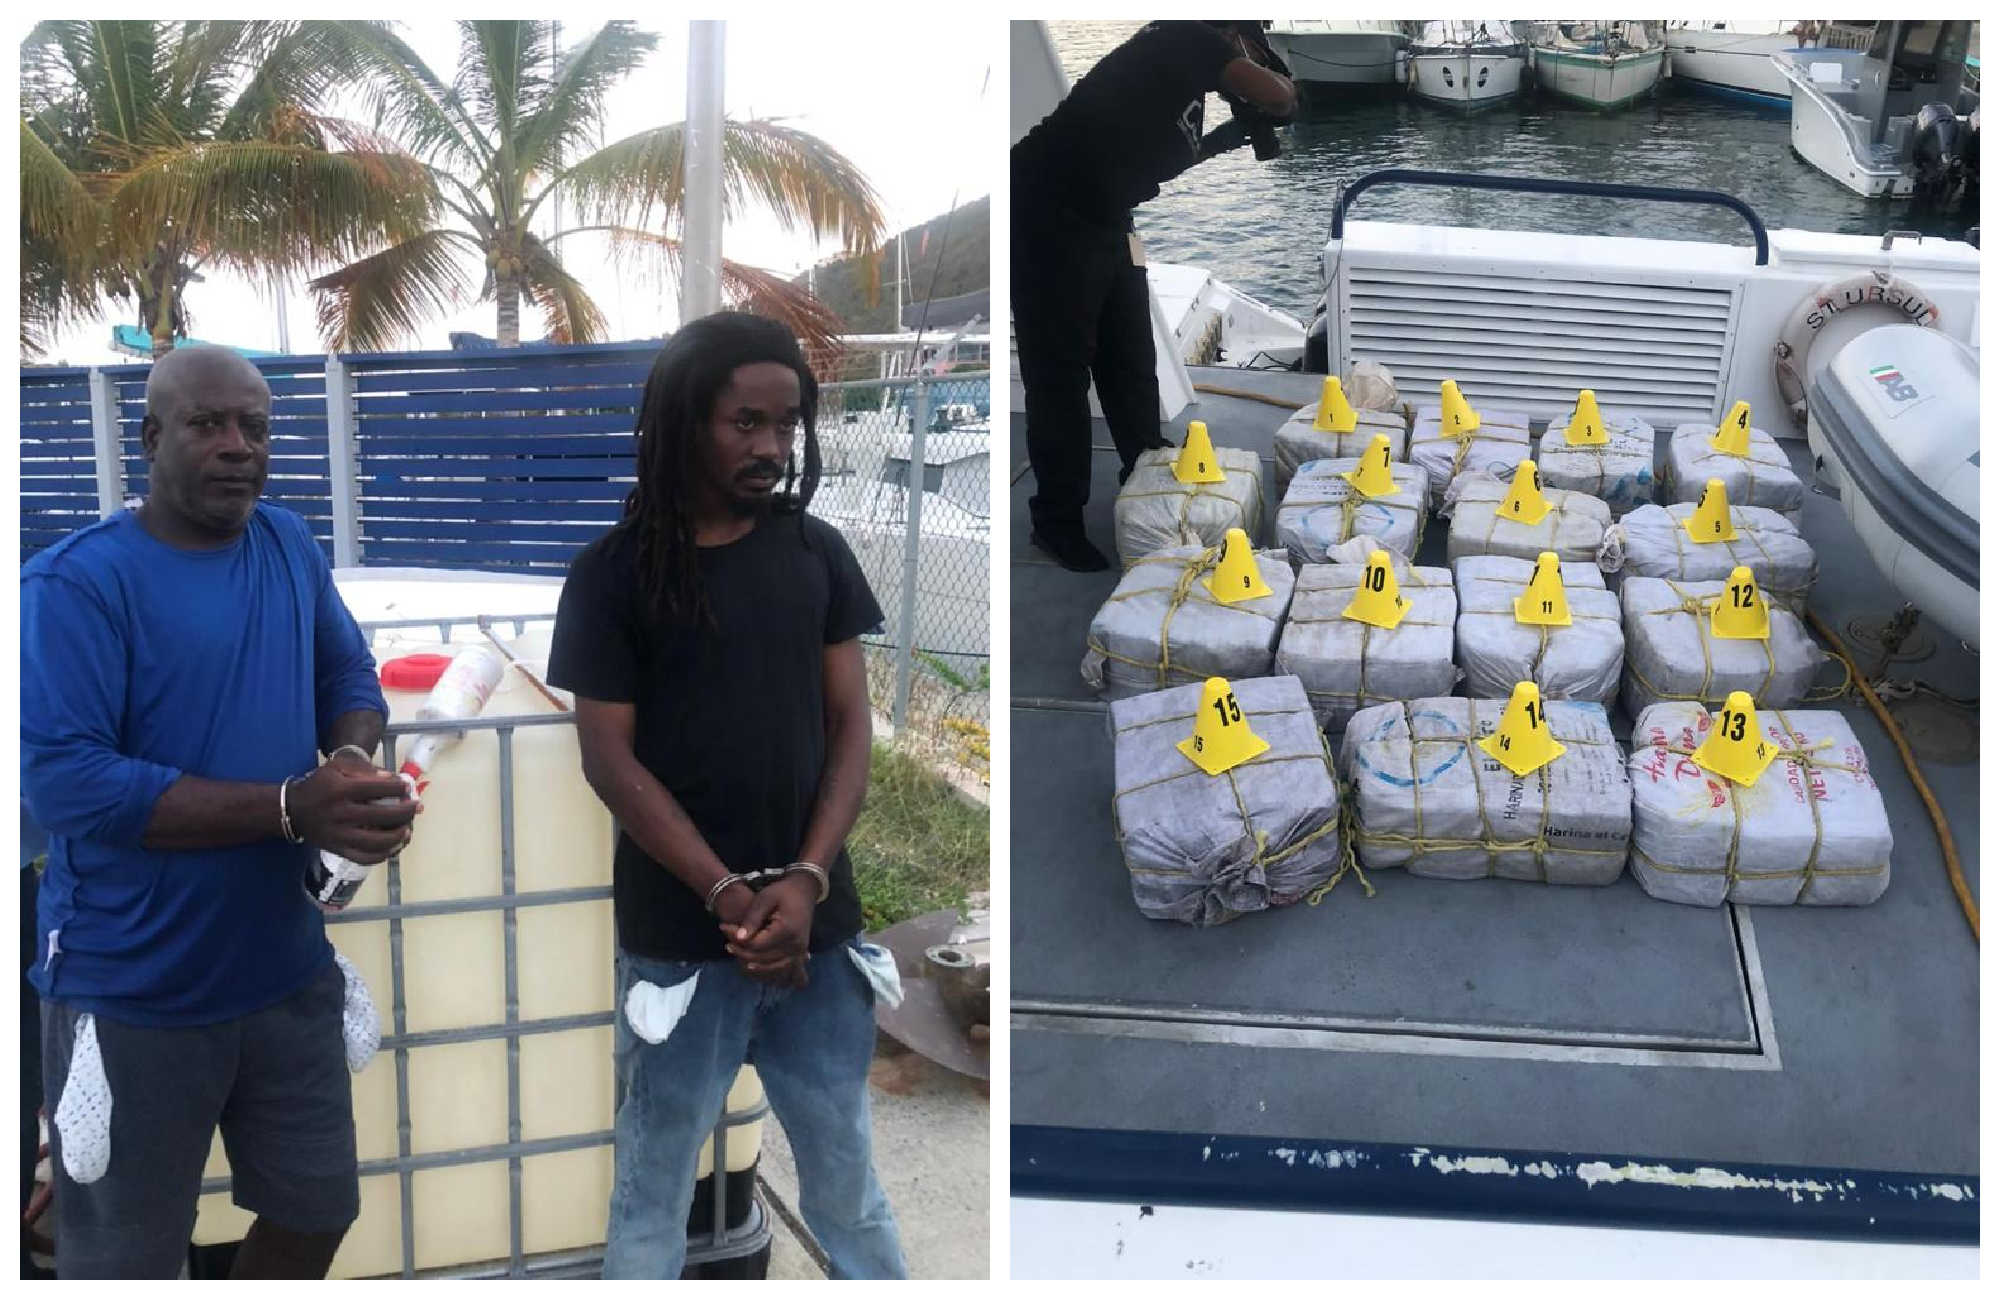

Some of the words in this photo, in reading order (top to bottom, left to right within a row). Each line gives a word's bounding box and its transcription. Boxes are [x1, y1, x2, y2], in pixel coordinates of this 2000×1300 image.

[1454, 413, 1461, 425] 2
[1737, 408, 1748, 430] 4
[1586, 424, 1592, 437] 3
[1383, 446, 1391, 468] 7
[1514, 500, 1520, 512] 6
[1714, 520, 1721, 533] 5
[1243, 575, 1251, 589] 9
[1365, 564, 1386, 593] 10
[1731, 584, 1754, 608] 12
[1542, 600, 1553, 615] 11
[1213, 692, 1241, 727] 15
[1720, 709, 1747, 742] 13
[1499, 734, 1511, 752] 14
